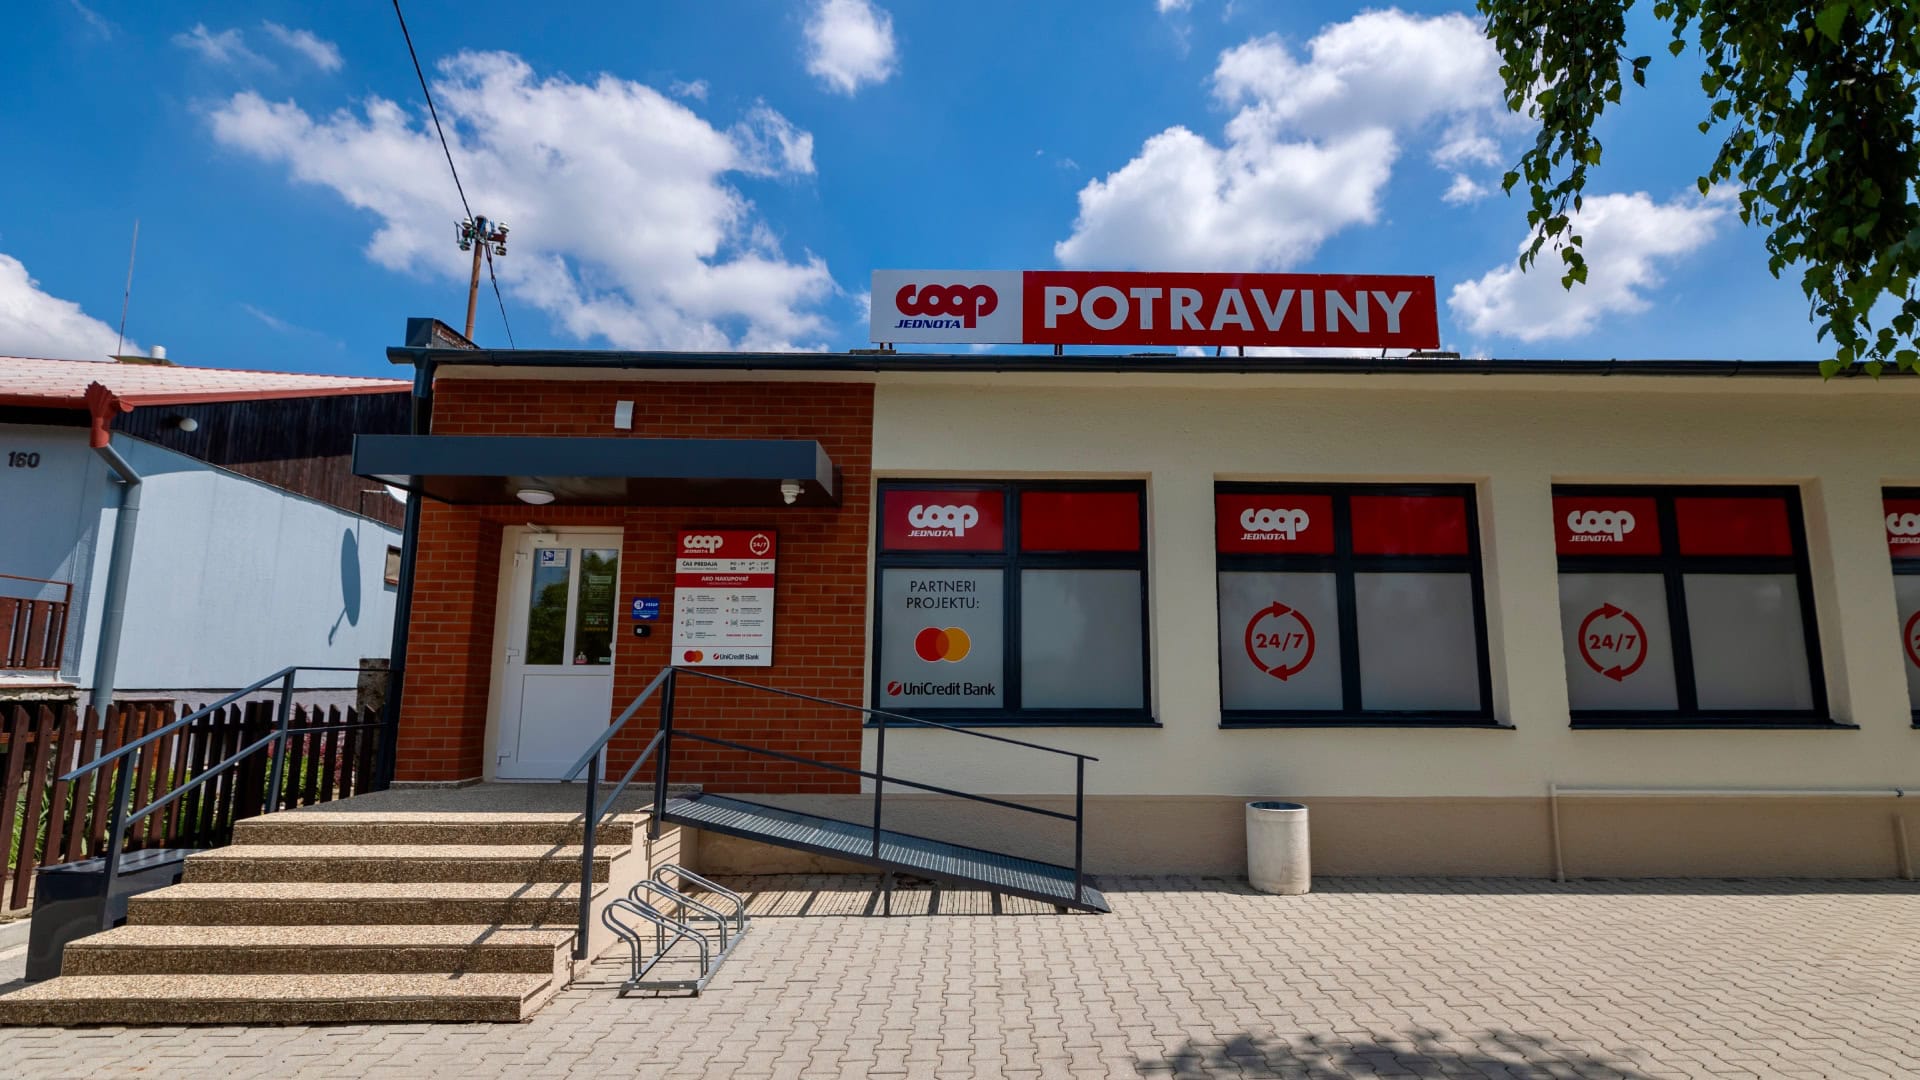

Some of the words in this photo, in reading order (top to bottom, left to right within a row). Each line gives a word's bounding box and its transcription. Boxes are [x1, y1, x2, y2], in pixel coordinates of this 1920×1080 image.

[895, 284, 999, 329] coop
[1044, 285, 1412, 334] POTRAVINY
[894, 319, 961, 329] JEDNOTA
[8, 451, 41, 469] 160
[908, 505, 979, 537] coop
[1240, 508, 1310, 541] coop
[1567, 510, 1636, 542] coop
[1886, 513, 1920, 536] co
[683, 535, 724, 554] coop
[1240, 533, 1286, 541] JEDNOTA
[910, 580, 976, 593] PARTNERI
[906, 597, 980, 609] PROJEKTU:
[1255, 633, 1304, 652] 24/7
[1588, 633, 1637, 652] 24/7
[903, 681, 960, 697] UniCredit
[963, 682, 996, 696] Bank
